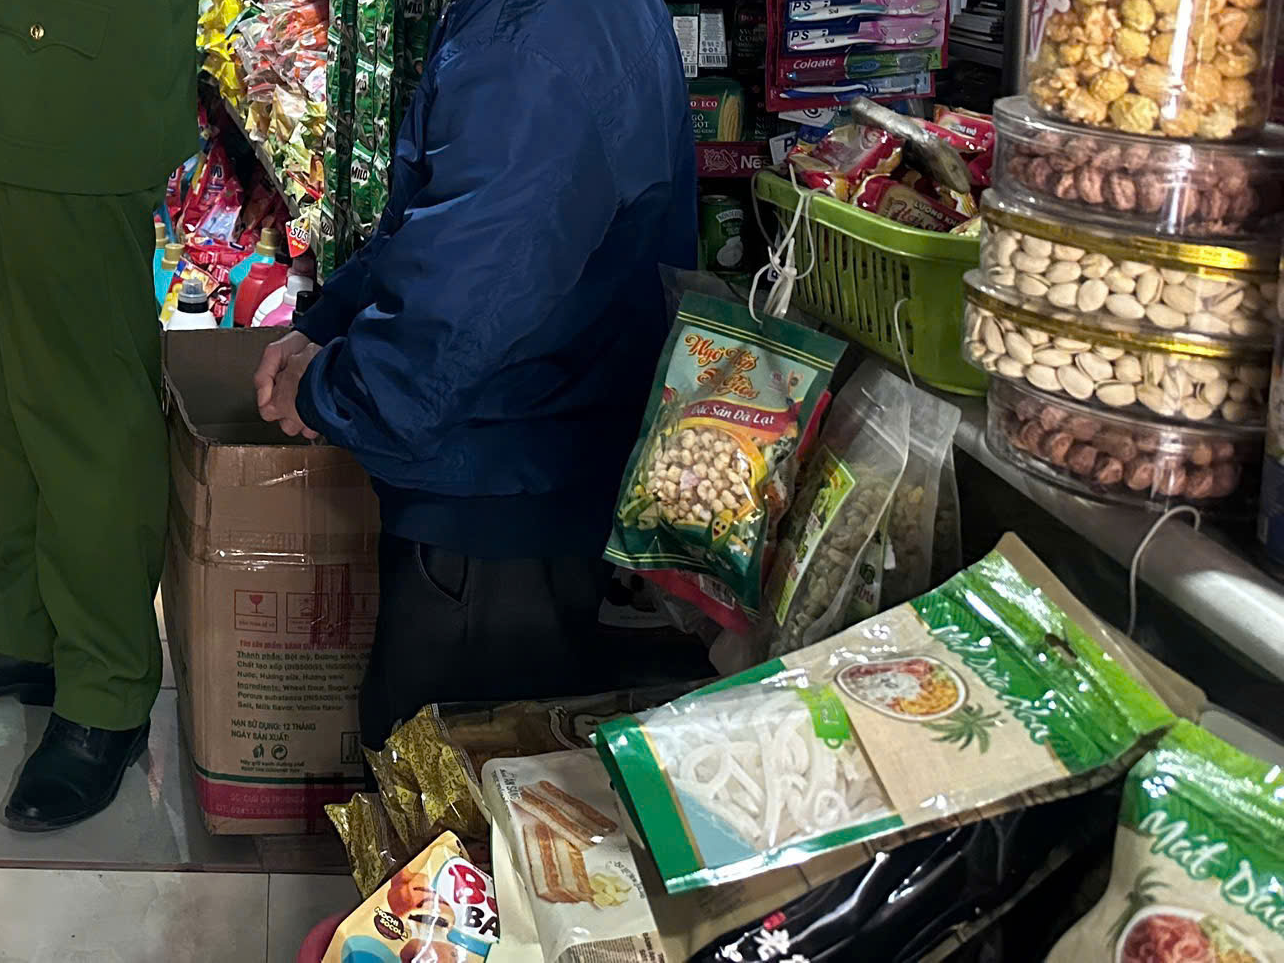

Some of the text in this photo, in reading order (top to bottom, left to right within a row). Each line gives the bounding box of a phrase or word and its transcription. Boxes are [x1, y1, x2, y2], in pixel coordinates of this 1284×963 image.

[793, 58, 836, 70] Colgate
[740, 155, 766, 170] Nes
[710, 404, 732, 418] Sản
[733, 408, 750, 422] Đà
[753, 413, 774, 426] Lạt
[292, 720, 316, 731] THÁNG
[375, 906, 400, 926] MOCHI
[380, 917, 409, 939] SOCOLA
